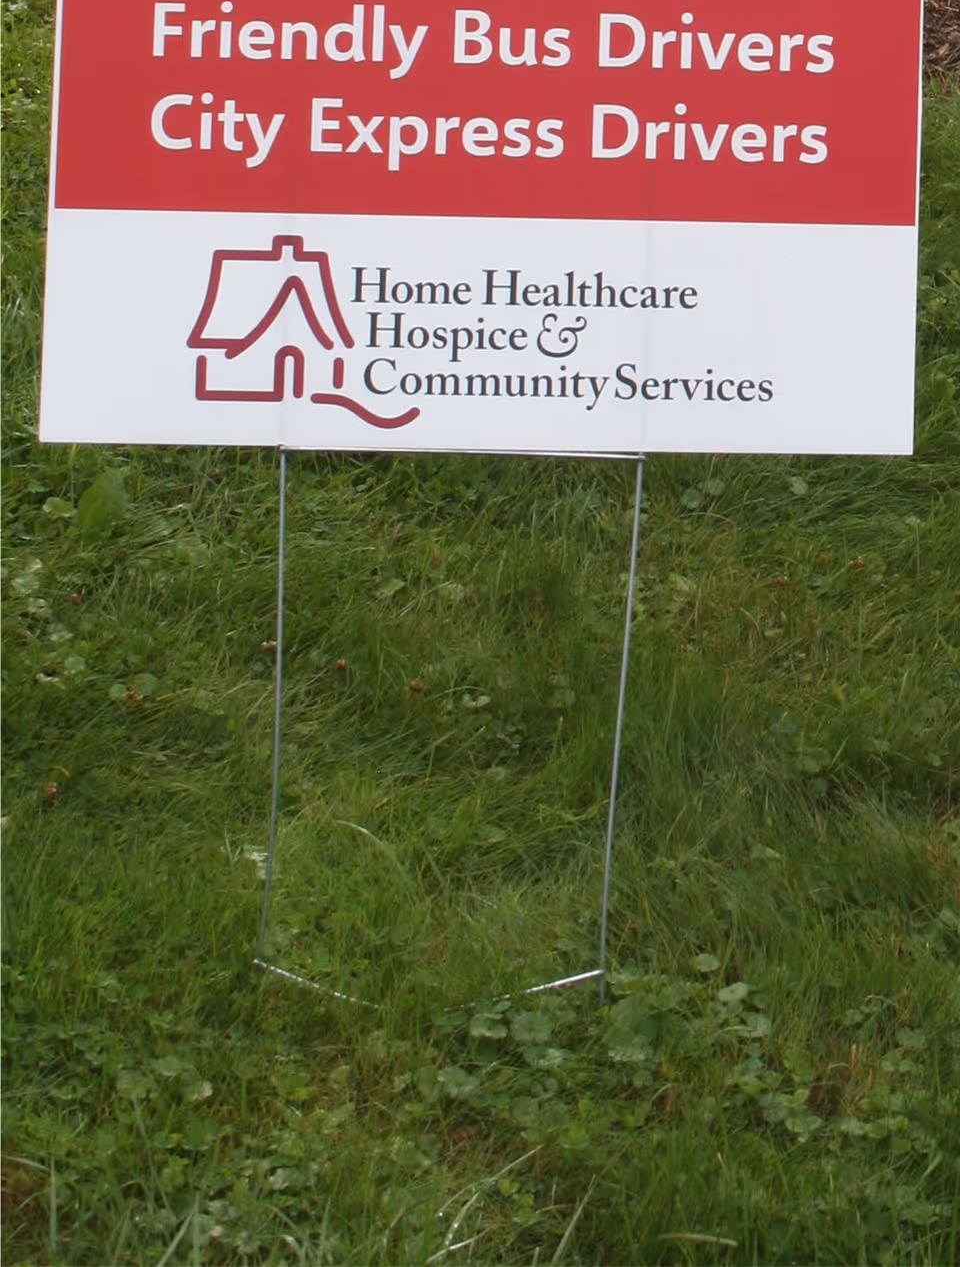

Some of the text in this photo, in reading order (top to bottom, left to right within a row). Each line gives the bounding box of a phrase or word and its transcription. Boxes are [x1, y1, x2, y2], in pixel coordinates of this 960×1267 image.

[153, 1, 834, 79] Friendly Bus Drivers
[151, 93, 827, 170] City Express Drivers
[351, 267, 697, 309] Home Healthcare
[366, 312, 587, 362] Hospice &
[364, 358, 773, 410] Community Services
